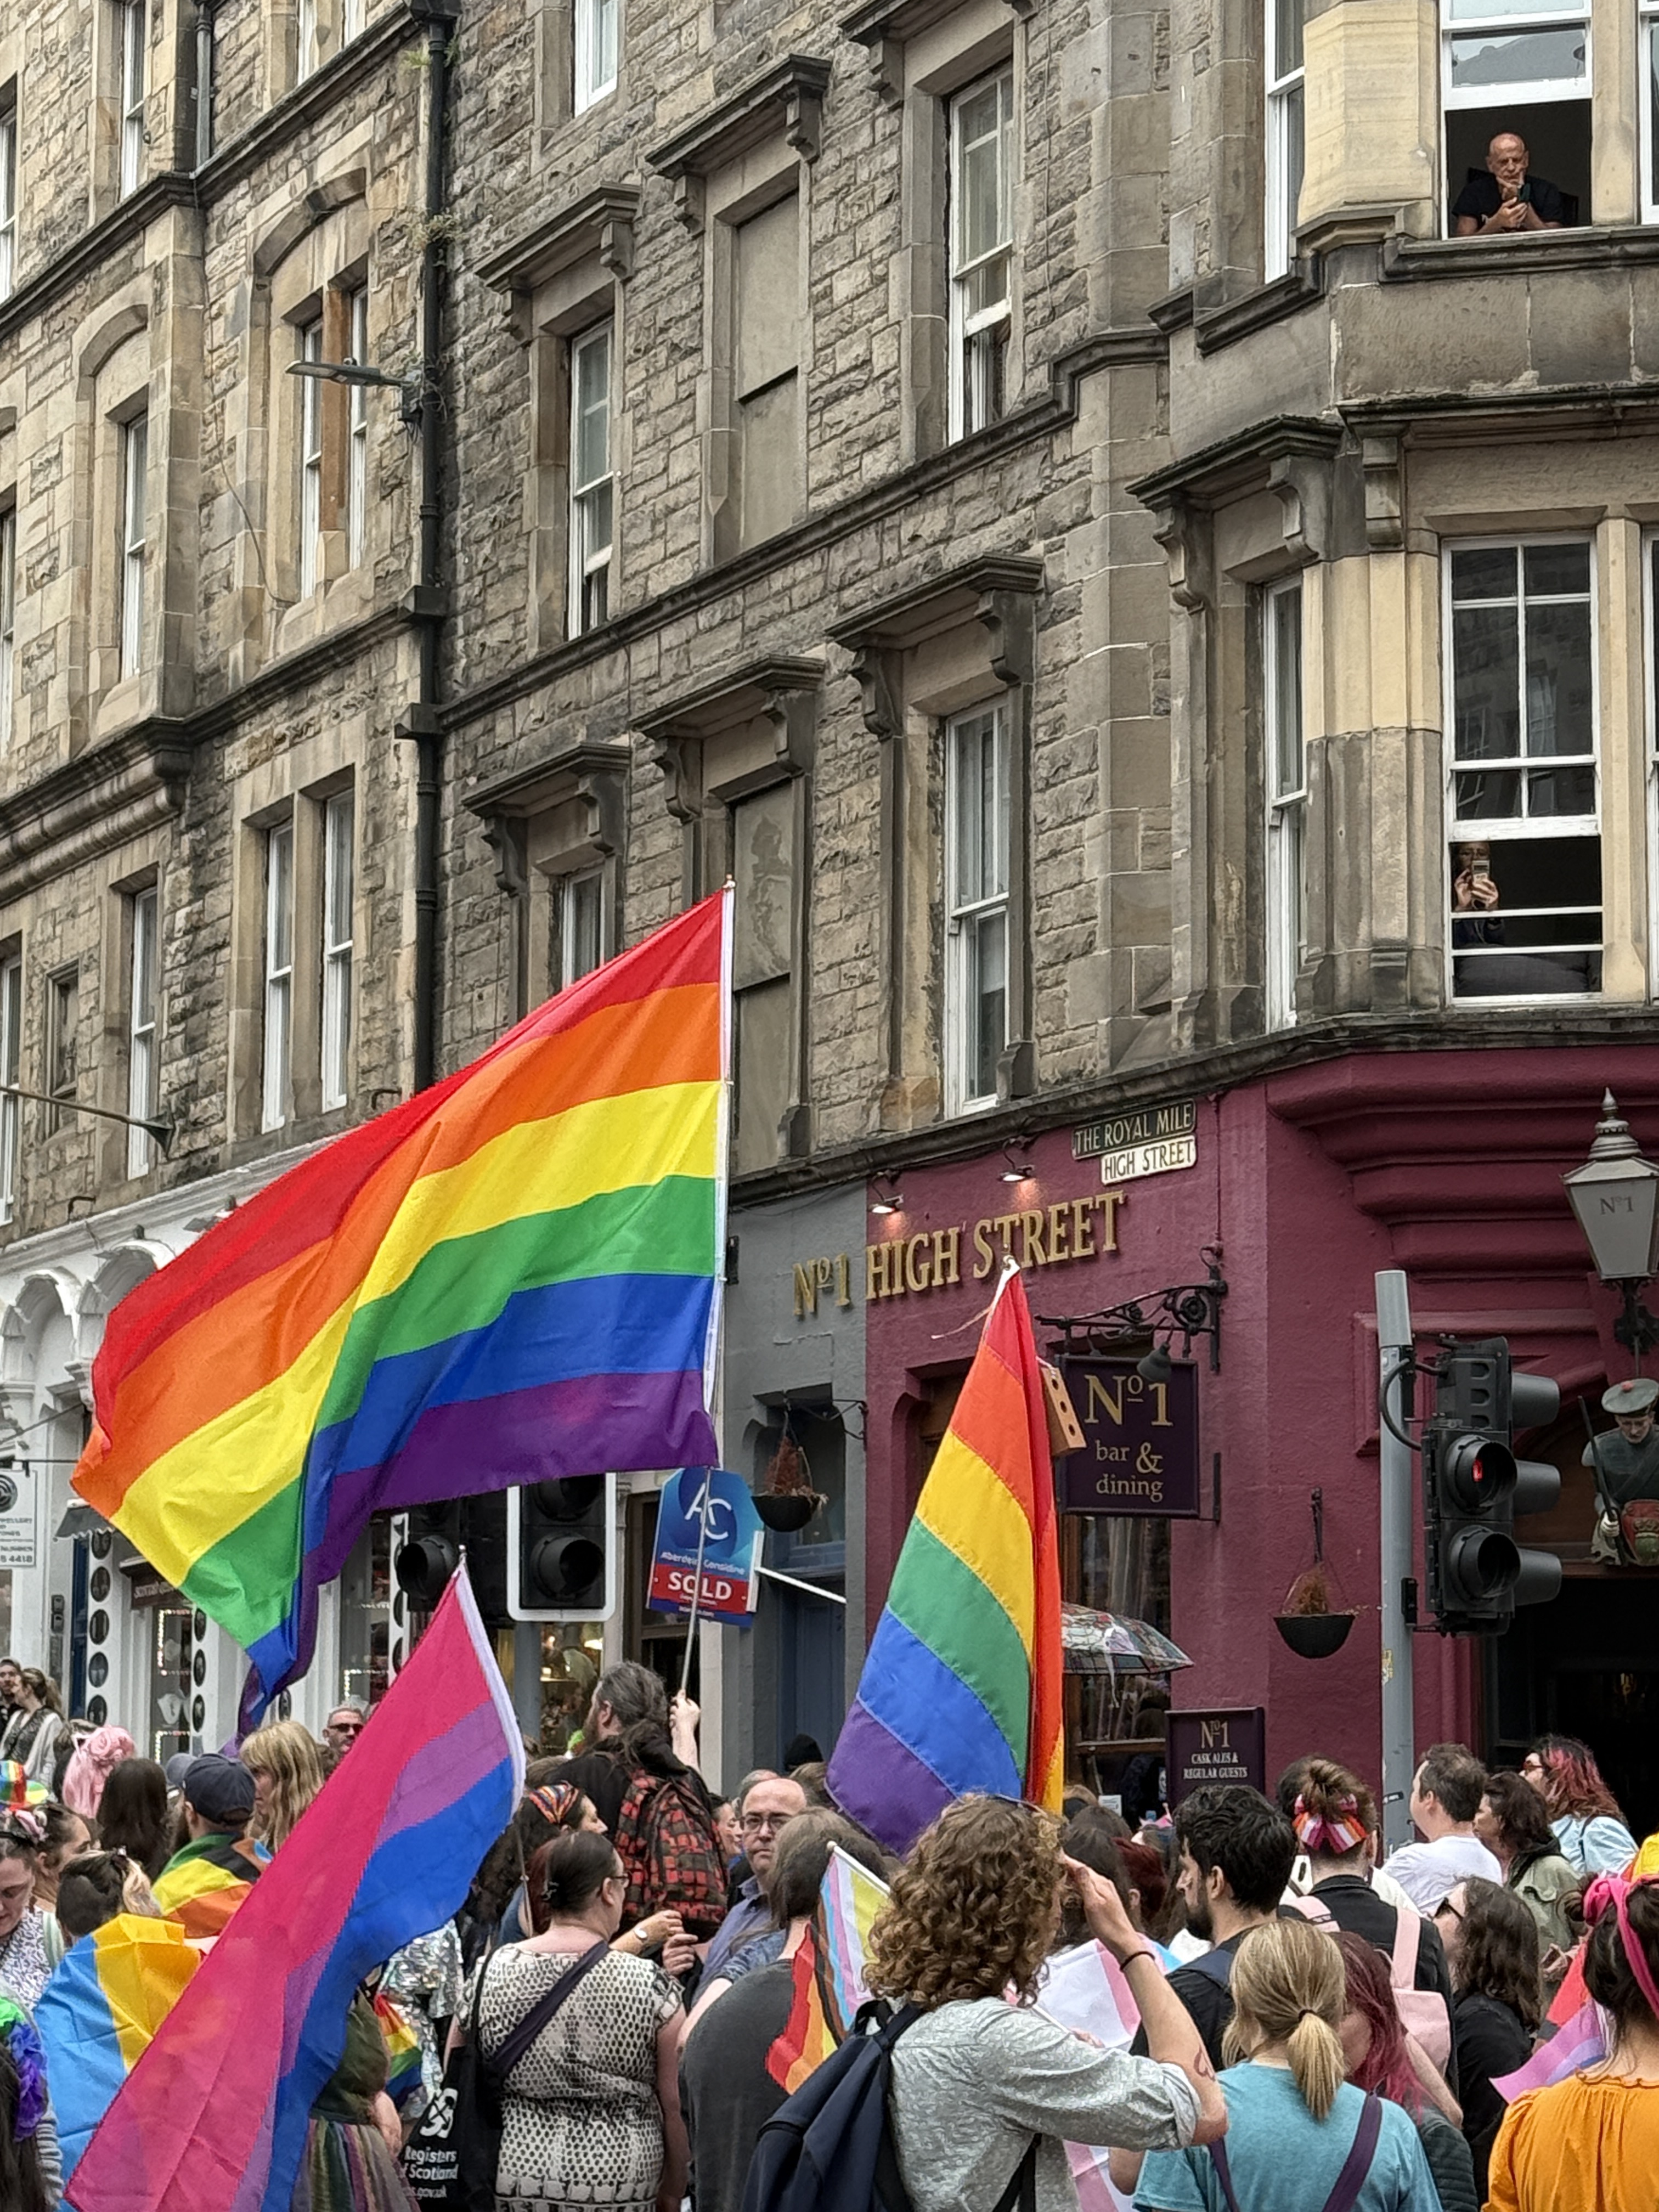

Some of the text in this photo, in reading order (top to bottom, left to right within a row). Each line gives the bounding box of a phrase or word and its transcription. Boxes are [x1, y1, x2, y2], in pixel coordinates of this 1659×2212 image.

[1075, 1104, 1192, 1154] THE ROYAL MILE
[1104, 1139, 1194, 1180] HIGH STREET
[866, 1227, 960, 1300] HIGH
[973, 1190, 1124, 1278] STREET
[1095, 1440, 1163, 1474] bar &
[1096, 1473, 1164, 1503] dining
[668, 1572, 732, 1600] SOLD
[1183, 1767, 1248, 1779] REGULAR GUESTS
[404, 2145, 457, 2165] Registers
[409, 2163, 459, 2180] Scotland
